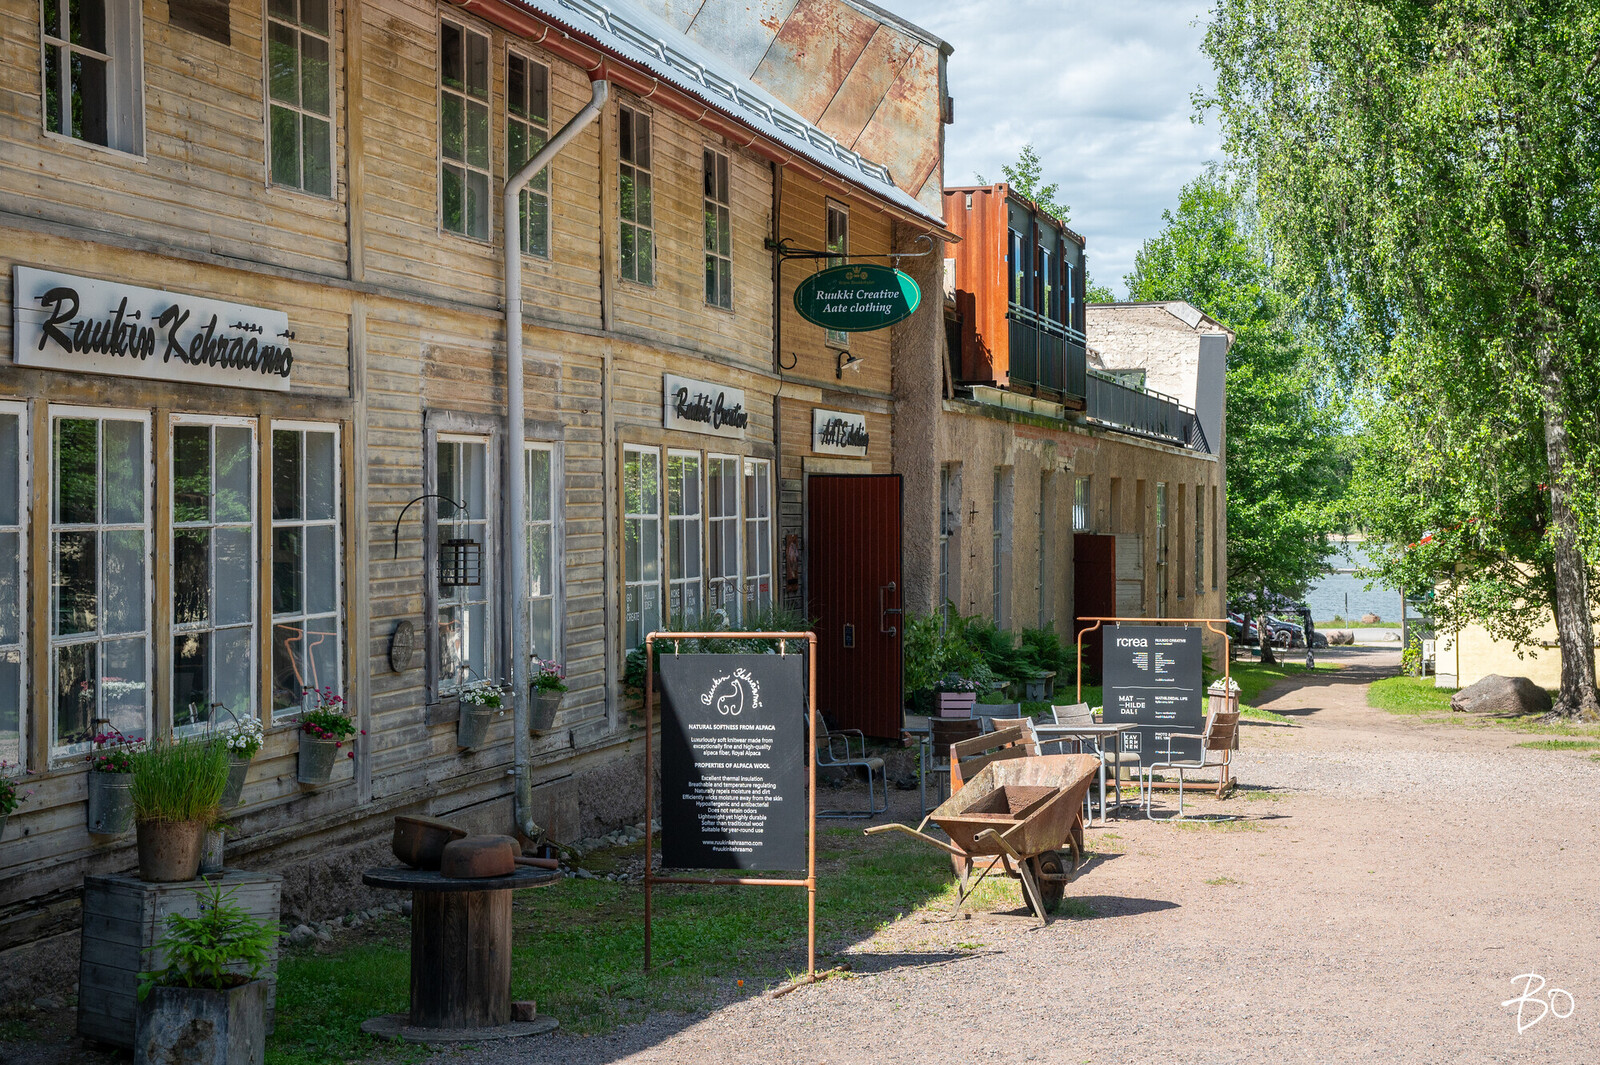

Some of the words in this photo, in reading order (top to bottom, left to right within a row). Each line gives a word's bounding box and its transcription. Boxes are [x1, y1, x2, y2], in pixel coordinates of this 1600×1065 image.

[816, 290, 854, 300] Ruukki
[856, 289, 900, 299] Creative
[823, 302, 848, 313] Aate
[850, 302, 893, 315] clothing
[38, 287, 156, 360] Ruukin
[676, 386, 712, 423] Ruukki
[1116, 638, 1148, 647] rcrea
[700, 670, 730, 706] Ruukin
